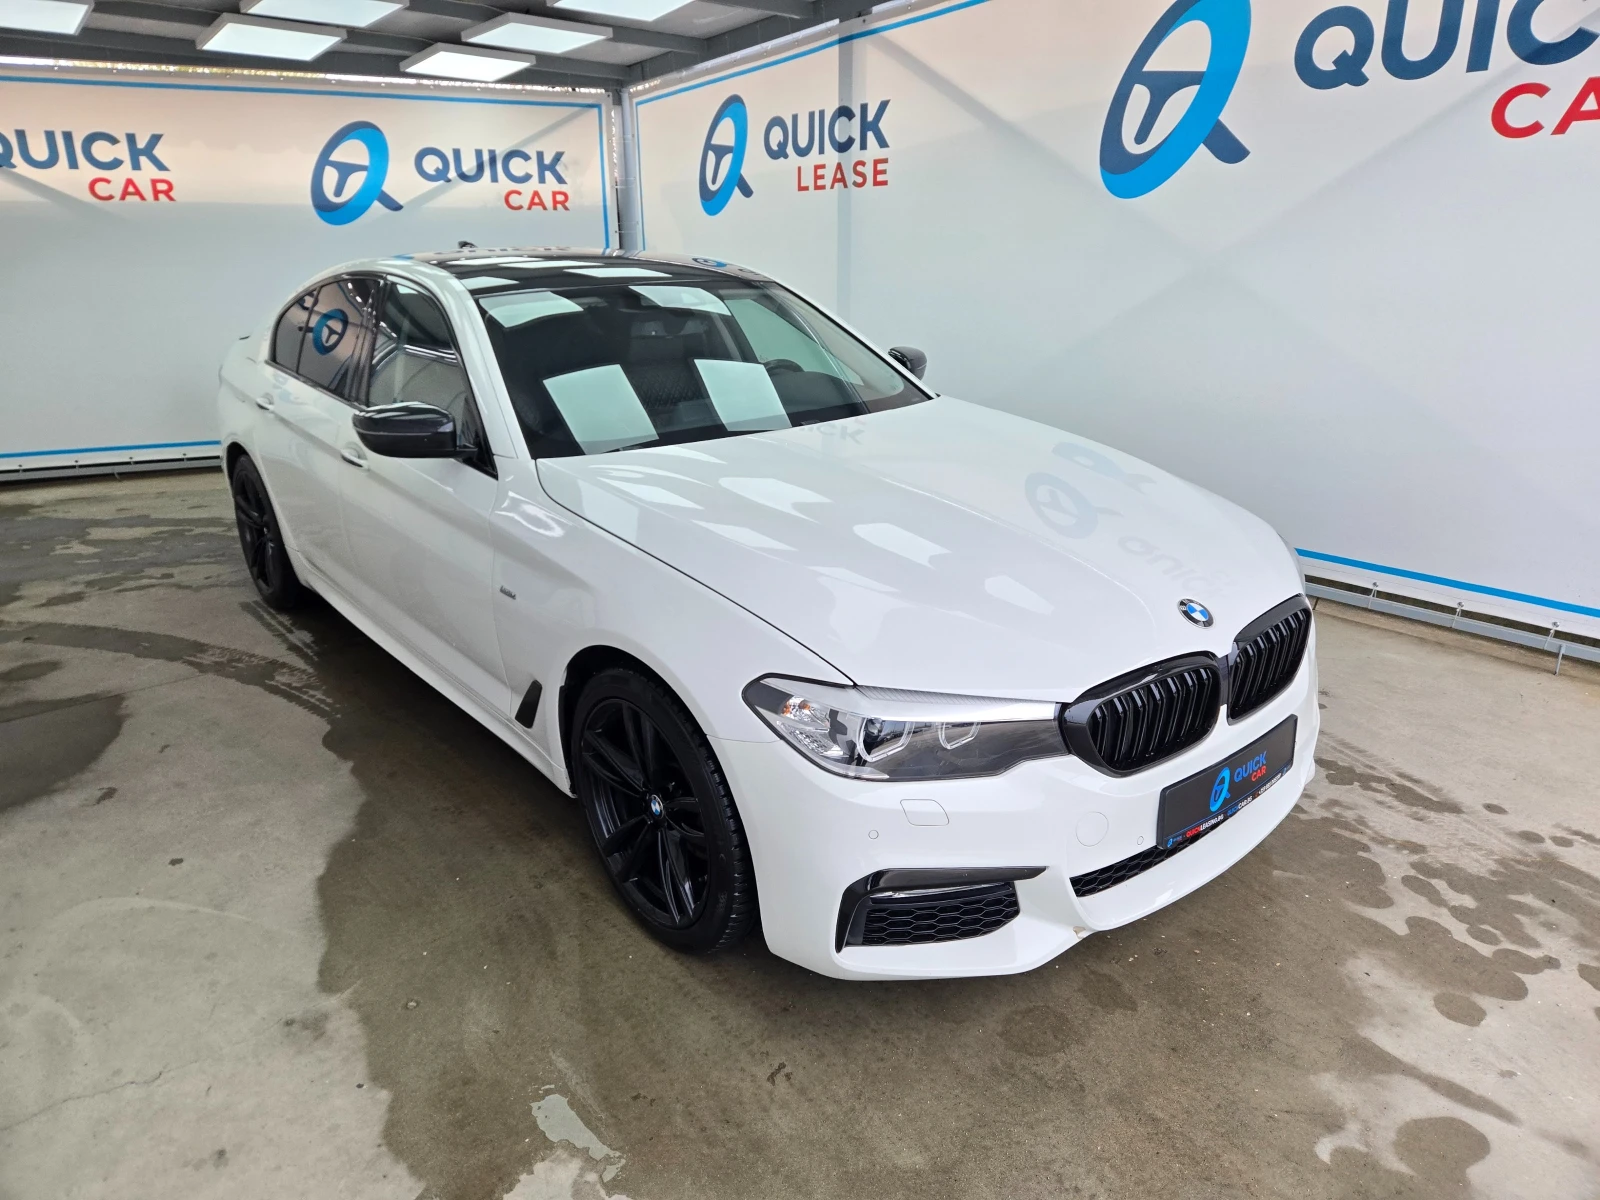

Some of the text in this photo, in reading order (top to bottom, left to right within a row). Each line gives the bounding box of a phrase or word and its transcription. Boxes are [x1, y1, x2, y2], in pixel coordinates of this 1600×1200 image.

[763, 99, 891, 160] QUICK
[414, 146, 568, 185] QUICK
[797, 157, 889, 192] LEASE
[88, 176, 176, 202] CAR
[504, 188, 570, 212] CAR
[1234, 752, 1266, 782] QUICK
[1252, 766, 1266, 781] CAR
